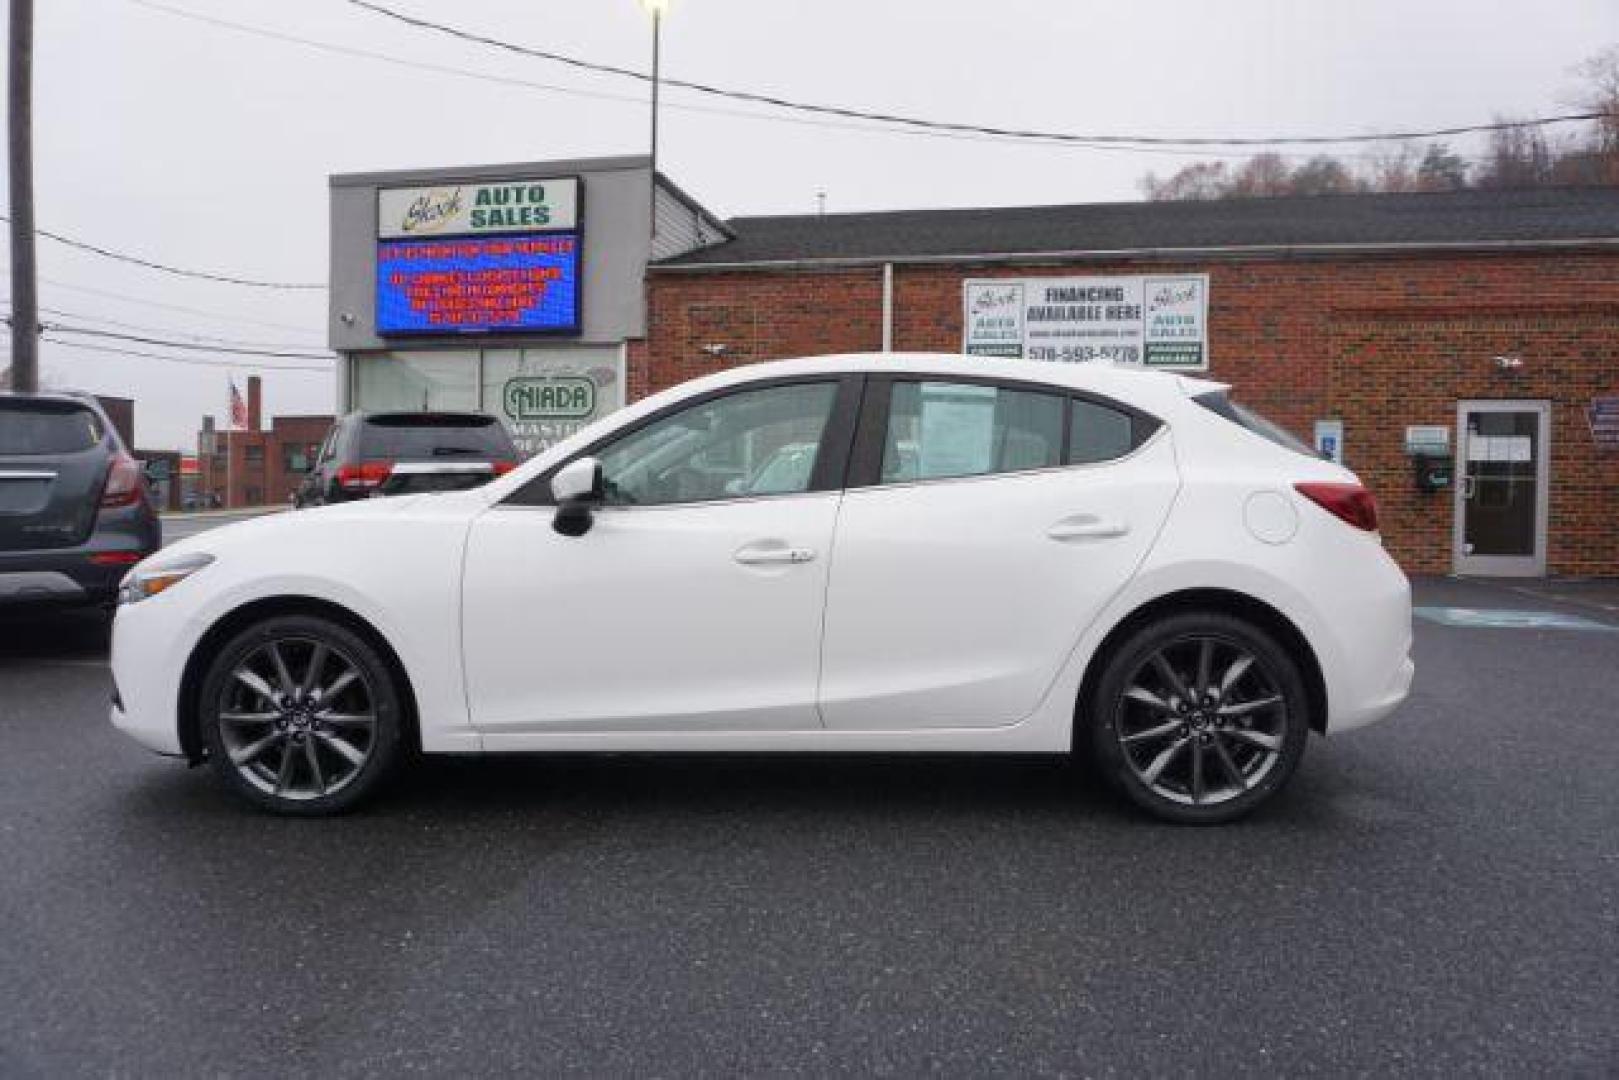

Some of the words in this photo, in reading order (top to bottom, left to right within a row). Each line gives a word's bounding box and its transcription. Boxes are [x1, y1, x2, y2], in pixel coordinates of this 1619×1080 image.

[474, 184, 545, 206] AUTO
[470, 206, 550, 228] SALES
[1045, 287, 1124, 302] FINANCING
[1027, 305, 1102, 322] AVAILABLE
[1105, 303, 1142, 320] HERE
